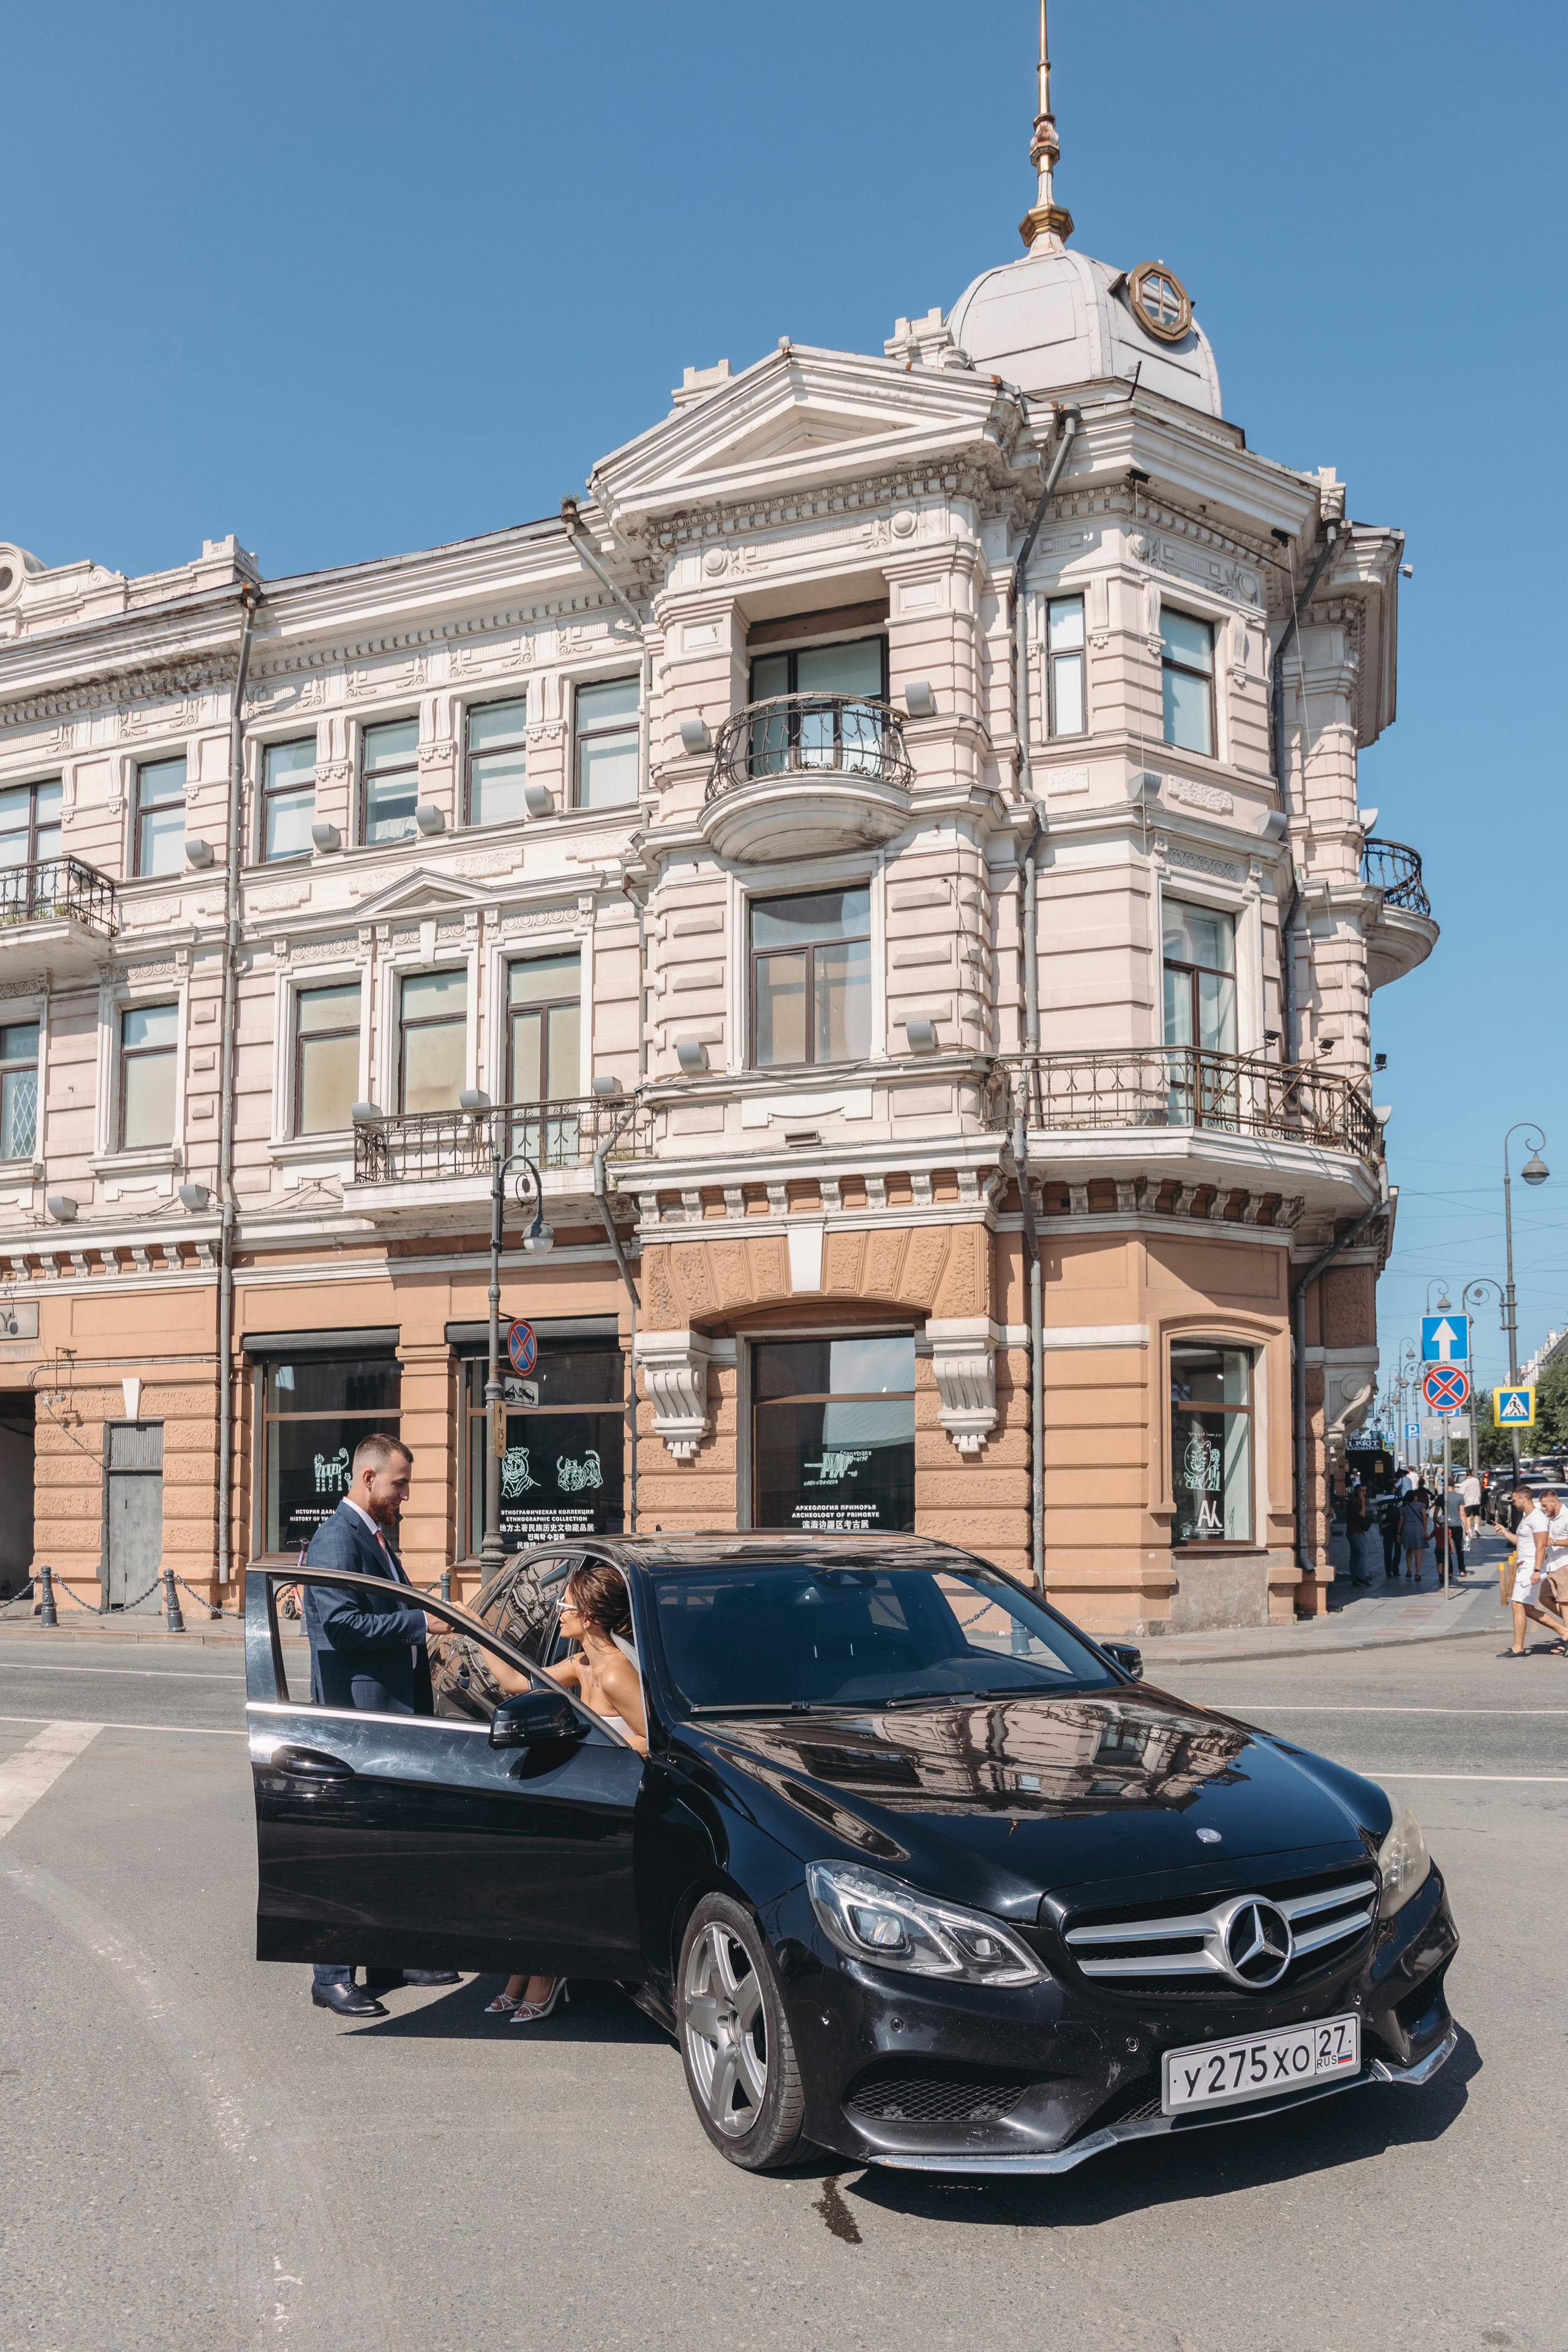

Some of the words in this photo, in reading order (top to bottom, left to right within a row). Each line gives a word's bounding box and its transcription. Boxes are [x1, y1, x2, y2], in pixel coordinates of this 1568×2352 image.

[497, 1428, 504, 1440] 75
[1318, 2024, 1346, 2057] 27
[1316, 2054, 1338, 2069] RUS
